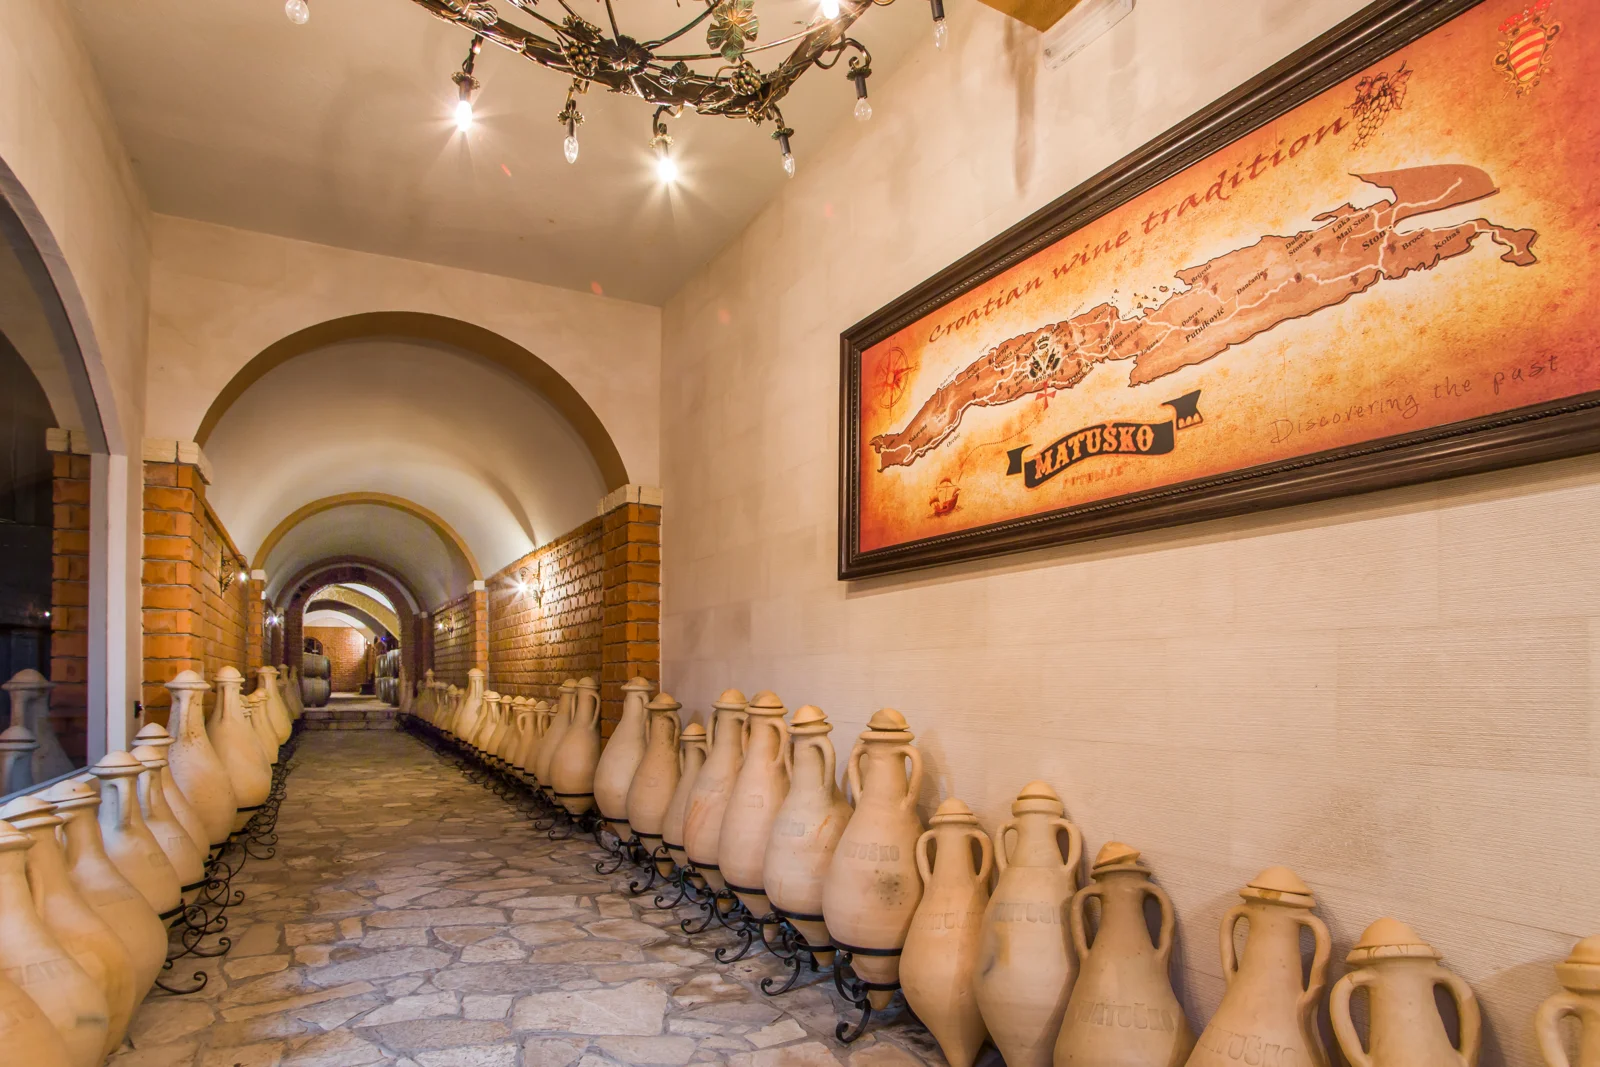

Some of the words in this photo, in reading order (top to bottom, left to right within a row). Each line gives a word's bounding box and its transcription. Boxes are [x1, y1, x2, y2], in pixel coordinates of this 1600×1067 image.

[929, 276, 1044, 343] Croatian
[1052, 230, 1131, 280] wine
[1141, 117, 1350, 235] tradition
[1332, 216, 1351, 234] Luka
[1353, 213, 1370, 229] Ston
[1362, 230, 1387, 252] Ston
[1185, 305, 1226, 343] Putniković
[1270, 392, 1420, 444] Discovering
[1434, 376, 1472, 399] the
[1493, 355, 1559, 395] past
[1034, 422, 1155, 480] MATUŠKO
